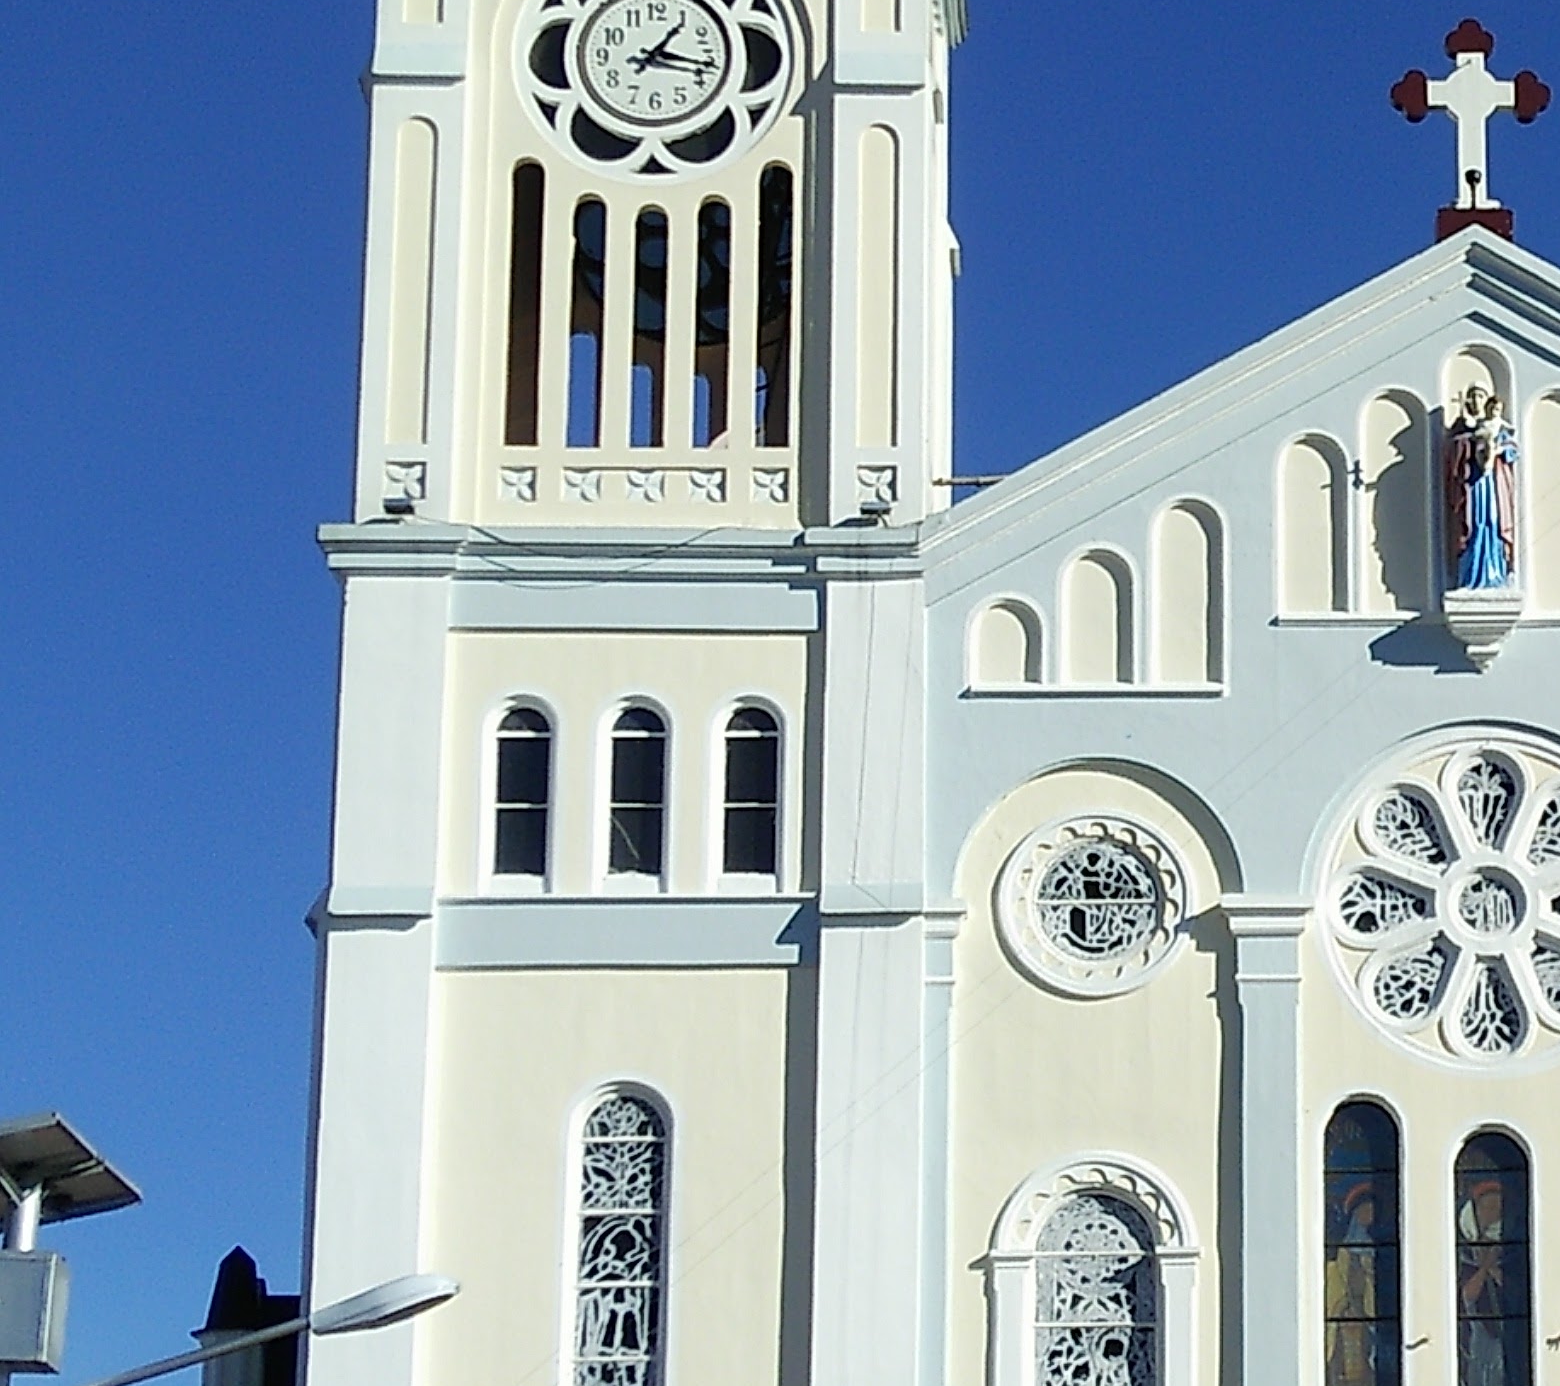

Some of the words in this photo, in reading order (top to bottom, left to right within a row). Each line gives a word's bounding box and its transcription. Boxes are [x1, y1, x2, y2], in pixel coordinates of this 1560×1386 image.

[626, 9, 641, 27] 11
[647, 2, 667, 21] 12
[604, 27, 625, 46] 10
[695, 26, 709, 45] 2
[596, 48, 609, 66] 9
[606, 69, 620, 88] 8
[626, 85, 640, 105] 7
[648, 91, 662, 110] 6
[673, 86, 687, 105] 5
